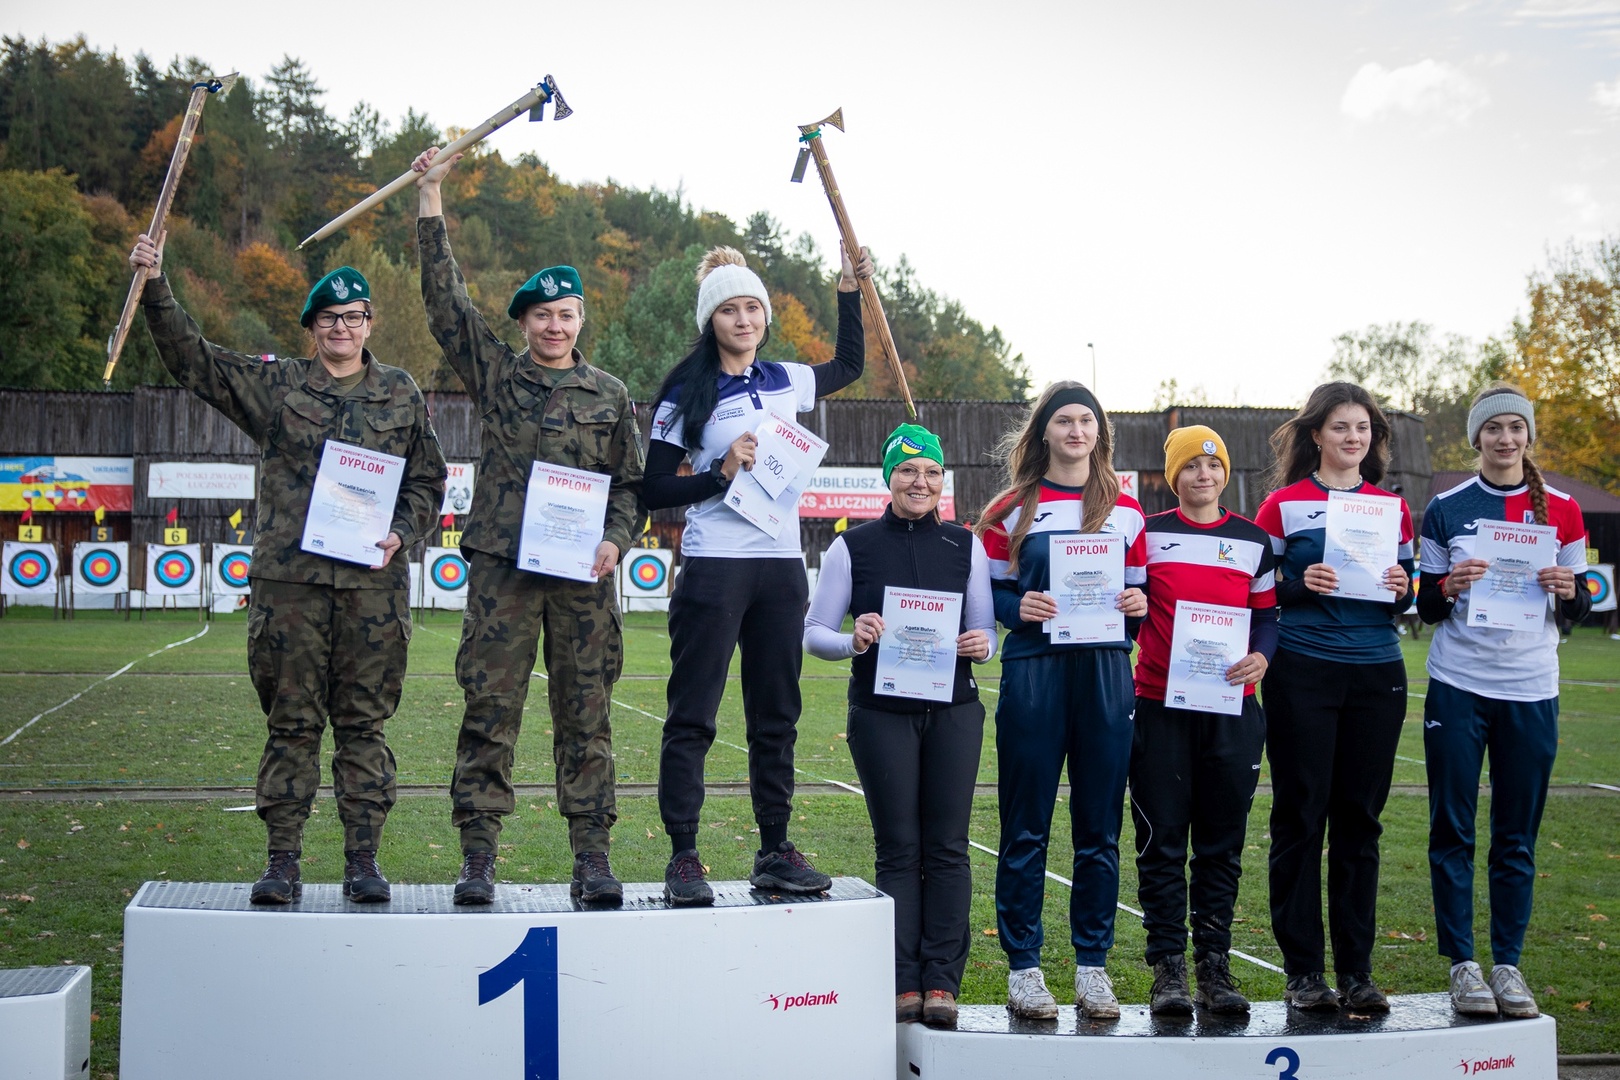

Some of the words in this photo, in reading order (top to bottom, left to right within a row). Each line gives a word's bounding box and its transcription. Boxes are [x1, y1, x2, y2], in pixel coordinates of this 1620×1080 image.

[775, 424, 810, 453] DYPLOM
[340, 455, 385, 475] DYPLOM
[210, 472, 250, 481] ZWIĄZEK
[807, 477, 876, 489] JUBILEUSZ
[188, 481, 237, 489] ŁUCZNICZY
[548, 475, 591, 493] DYPLOM
[1344, 503, 1383, 517] DYPLOM
[24, 528, 33, 539] 4
[97, 527, 107, 541] 5
[171, 531, 180, 543] 6
[235, 530, 246, 544] 7
[445, 534, 460, 546] 10
[1494, 531, 1538, 545] DYPLOM
[641, 536, 659, 549] 13
[1066, 545, 1108, 555] DYPLOM
[901, 599, 944, 612] DYPLOM
[1191, 613, 1233, 627] DYPLOM
[478, 926, 558, 1080] 1
[784, 990, 839, 1011] polanik
[1265, 1046, 1300, 1080] 3
[1473, 1054, 1515, 1075] polanik
